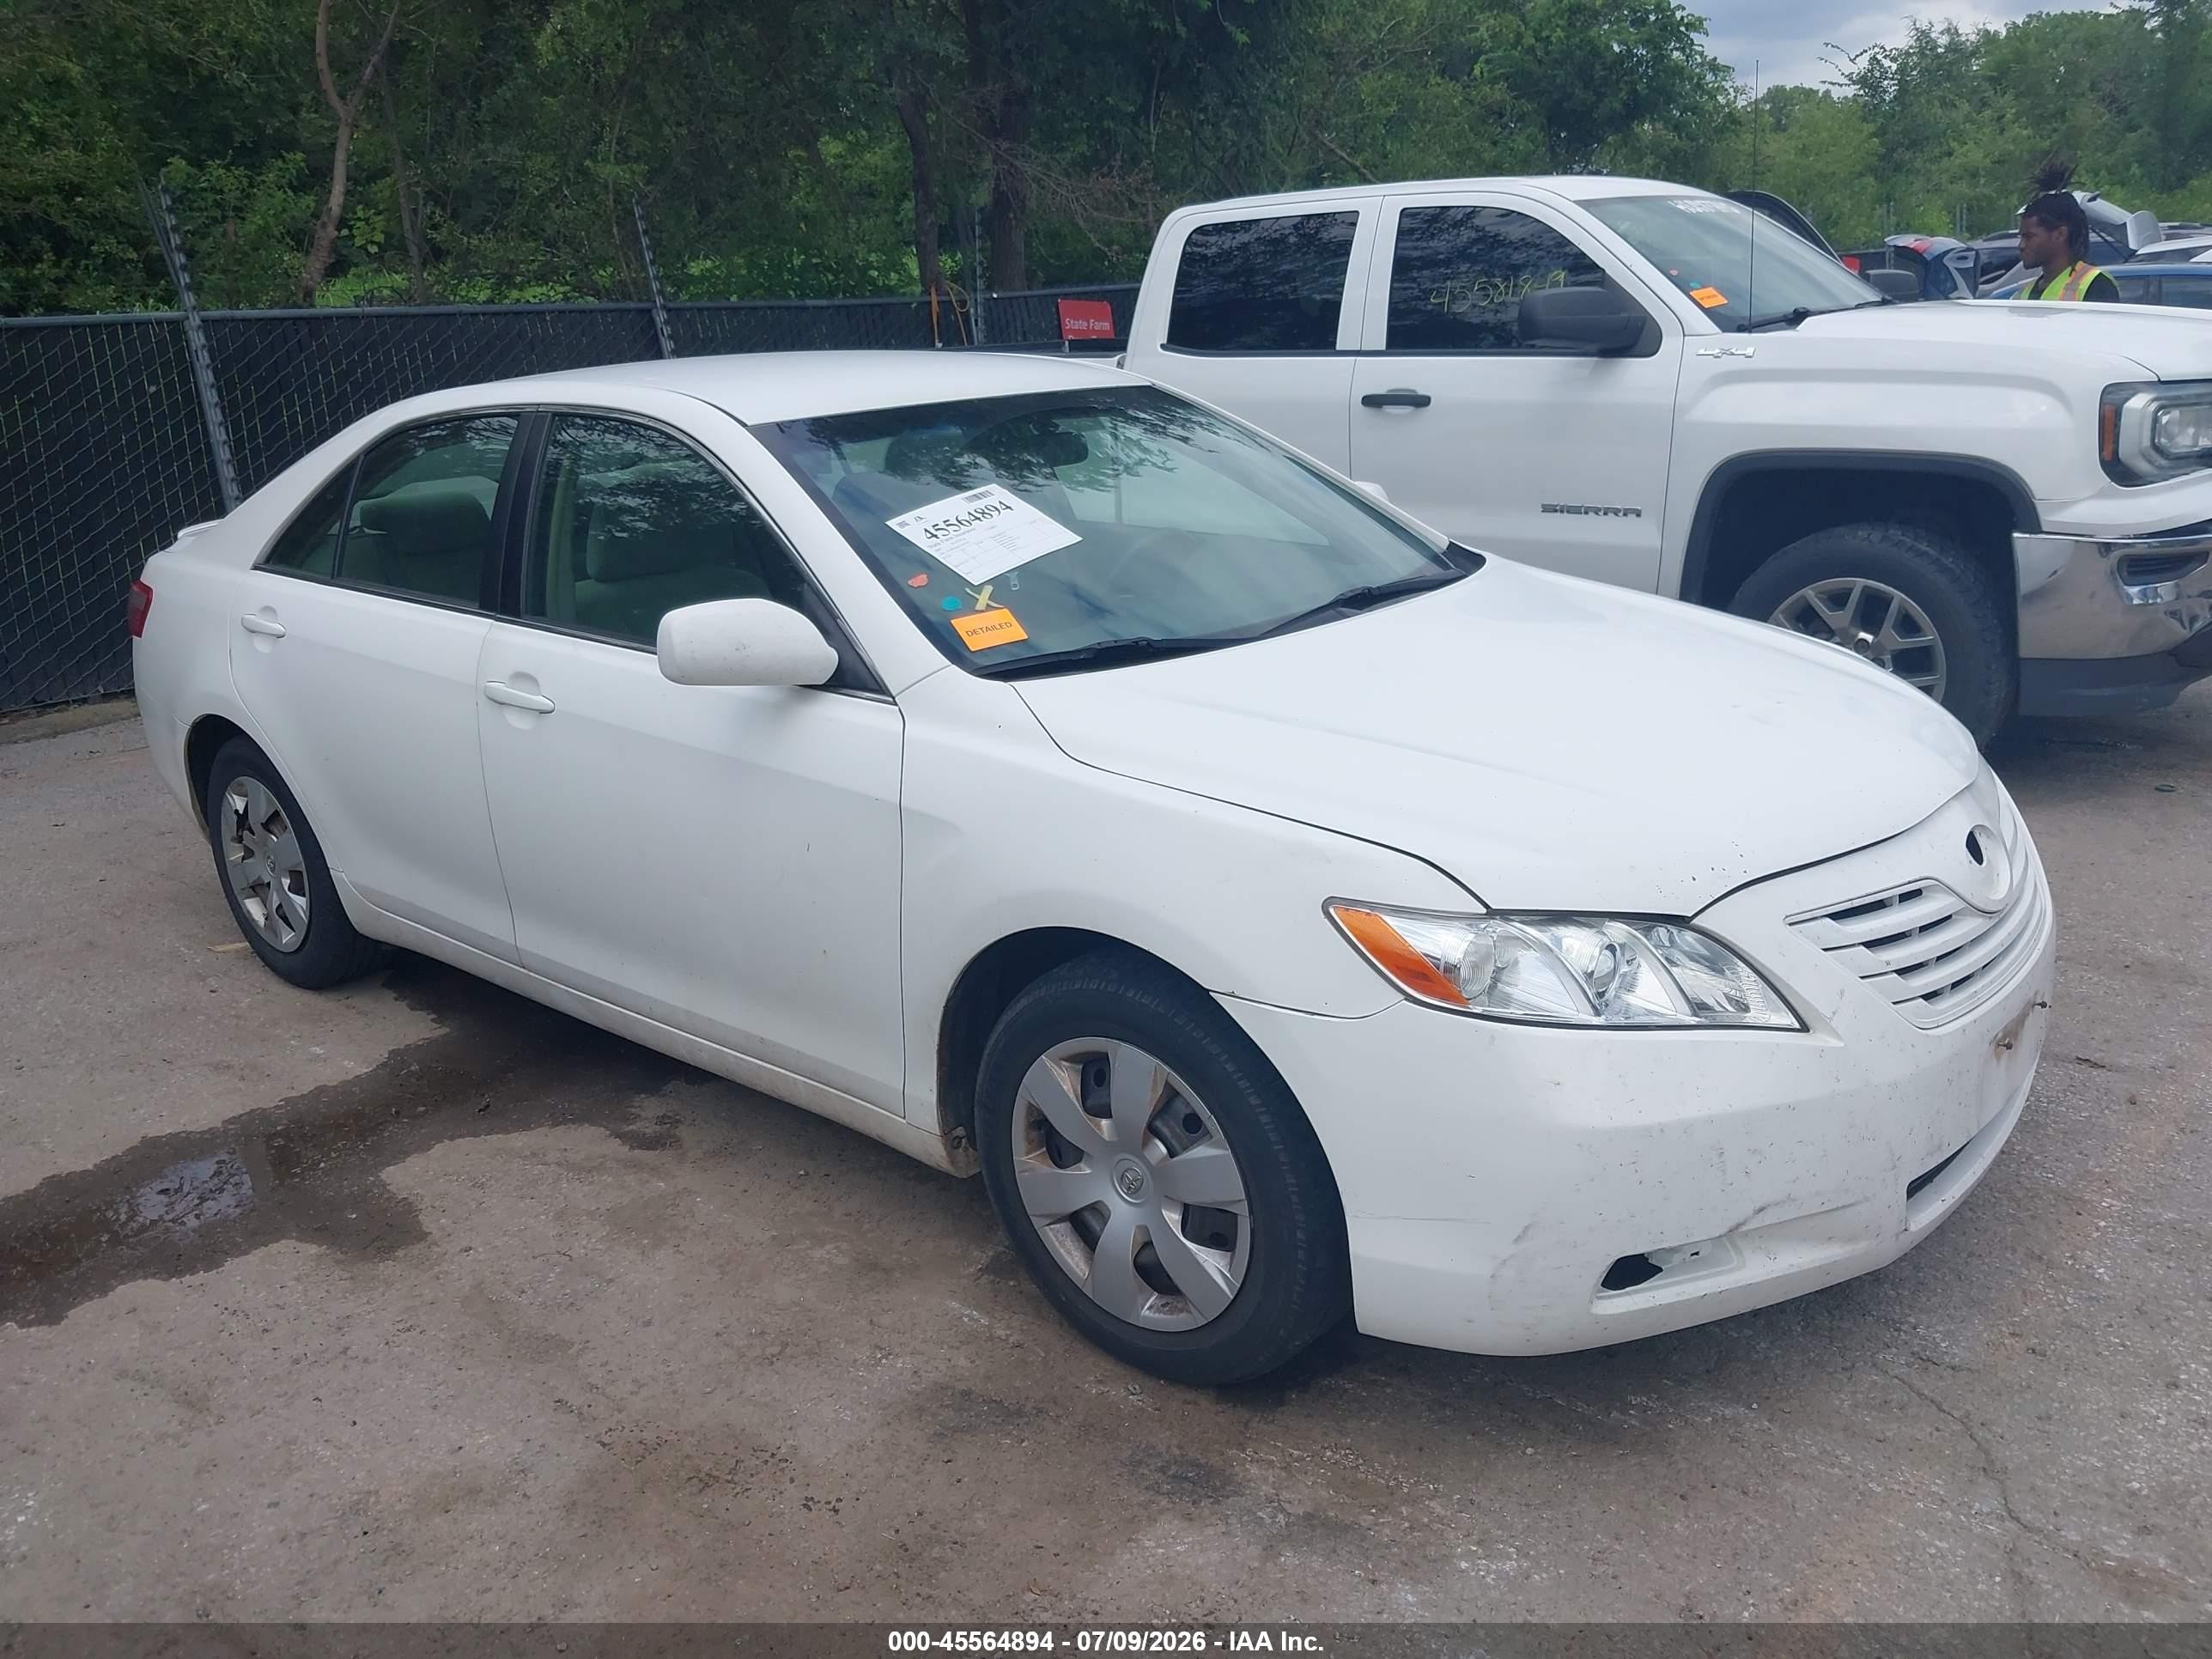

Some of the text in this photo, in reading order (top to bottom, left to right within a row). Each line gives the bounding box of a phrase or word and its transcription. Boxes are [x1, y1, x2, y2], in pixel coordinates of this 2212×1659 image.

[1065, 318, 1110, 331] State Farm
[1540, 503, 1642, 517] SIERRA
[923, 500, 1014, 539] 45564894
[965, 621, 1012, 637] DETAILED
